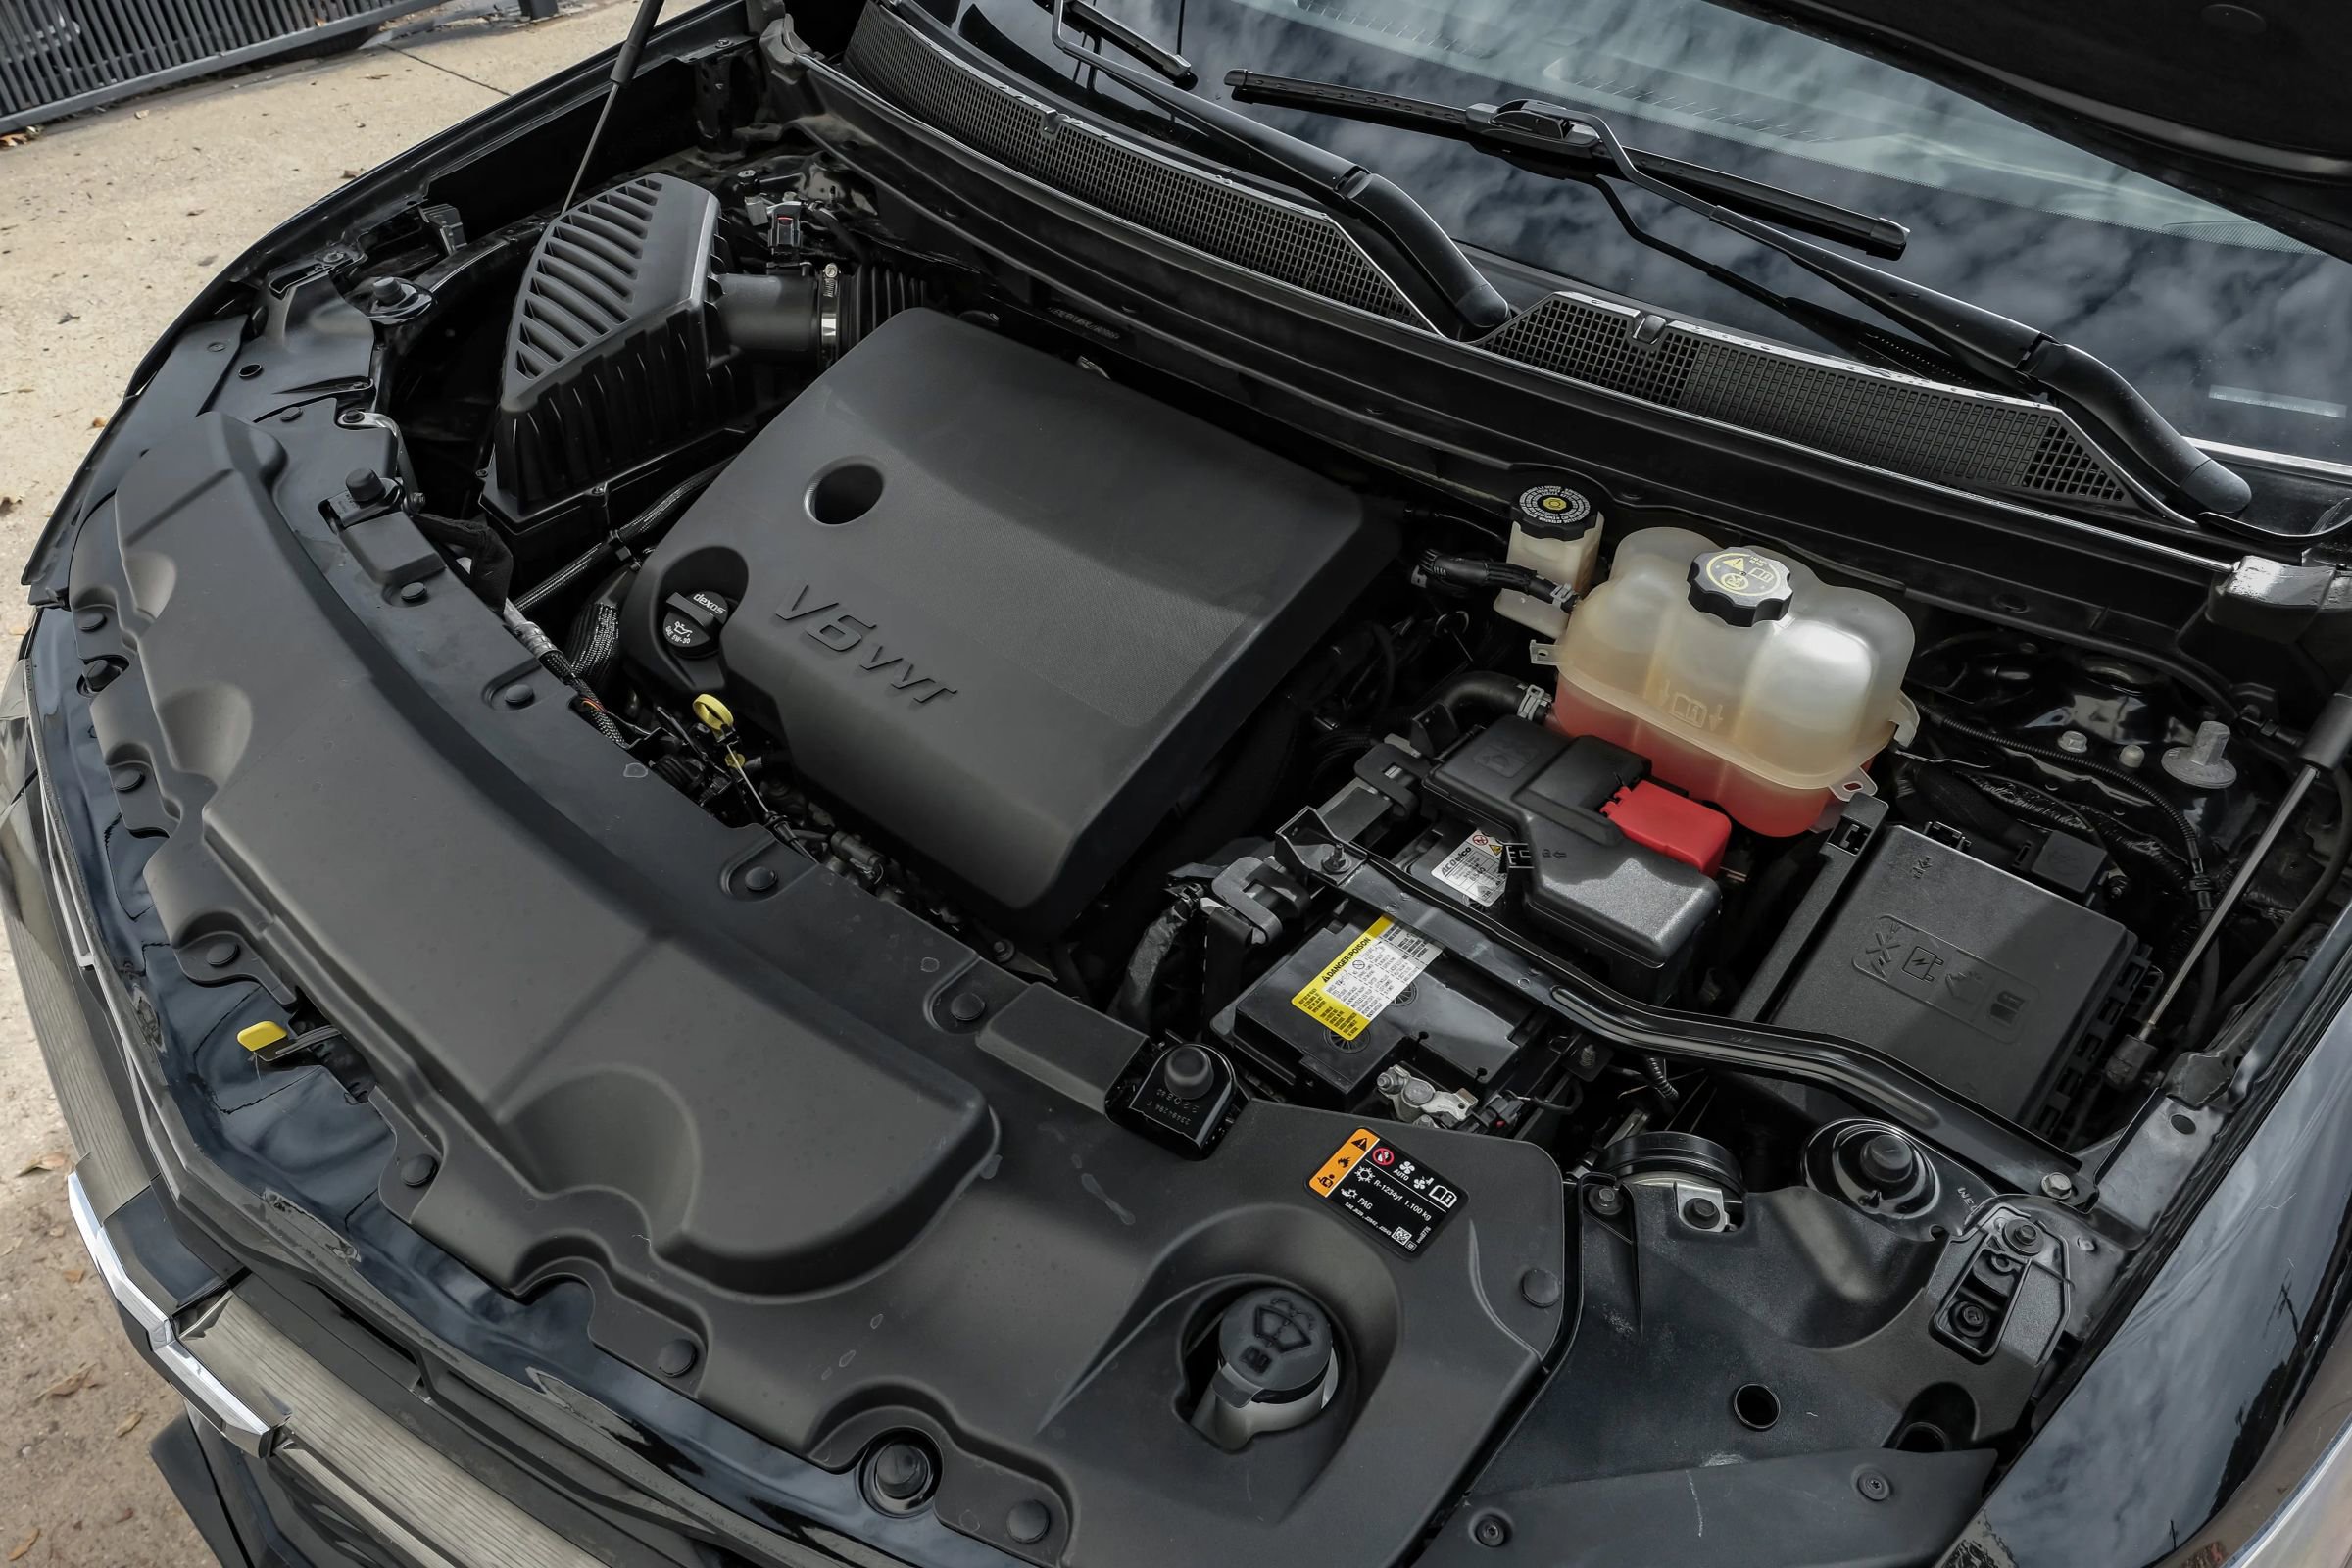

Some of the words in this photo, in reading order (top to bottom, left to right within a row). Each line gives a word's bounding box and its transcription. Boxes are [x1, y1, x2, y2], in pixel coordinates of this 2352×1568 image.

[692, 593, 727, 615] dexos
[665, 625, 674, 637] SAE
[671, 634, 691, 644] 5W-30
[775, 584, 877, 652] V6
[859, 645, 958, 704] VVT
[1326, 936, 1371, 978] DANGER/POISON
[1393, 1169, 1409, 1181] AUTO
[1357, 1197, 1374, 1210] PAG
[1373, 1179, 1403, 1201] R-1234yf
[1404, 1200, 1423, 1215] 1.100
[1420, 1209, 1432, 1222] kg
